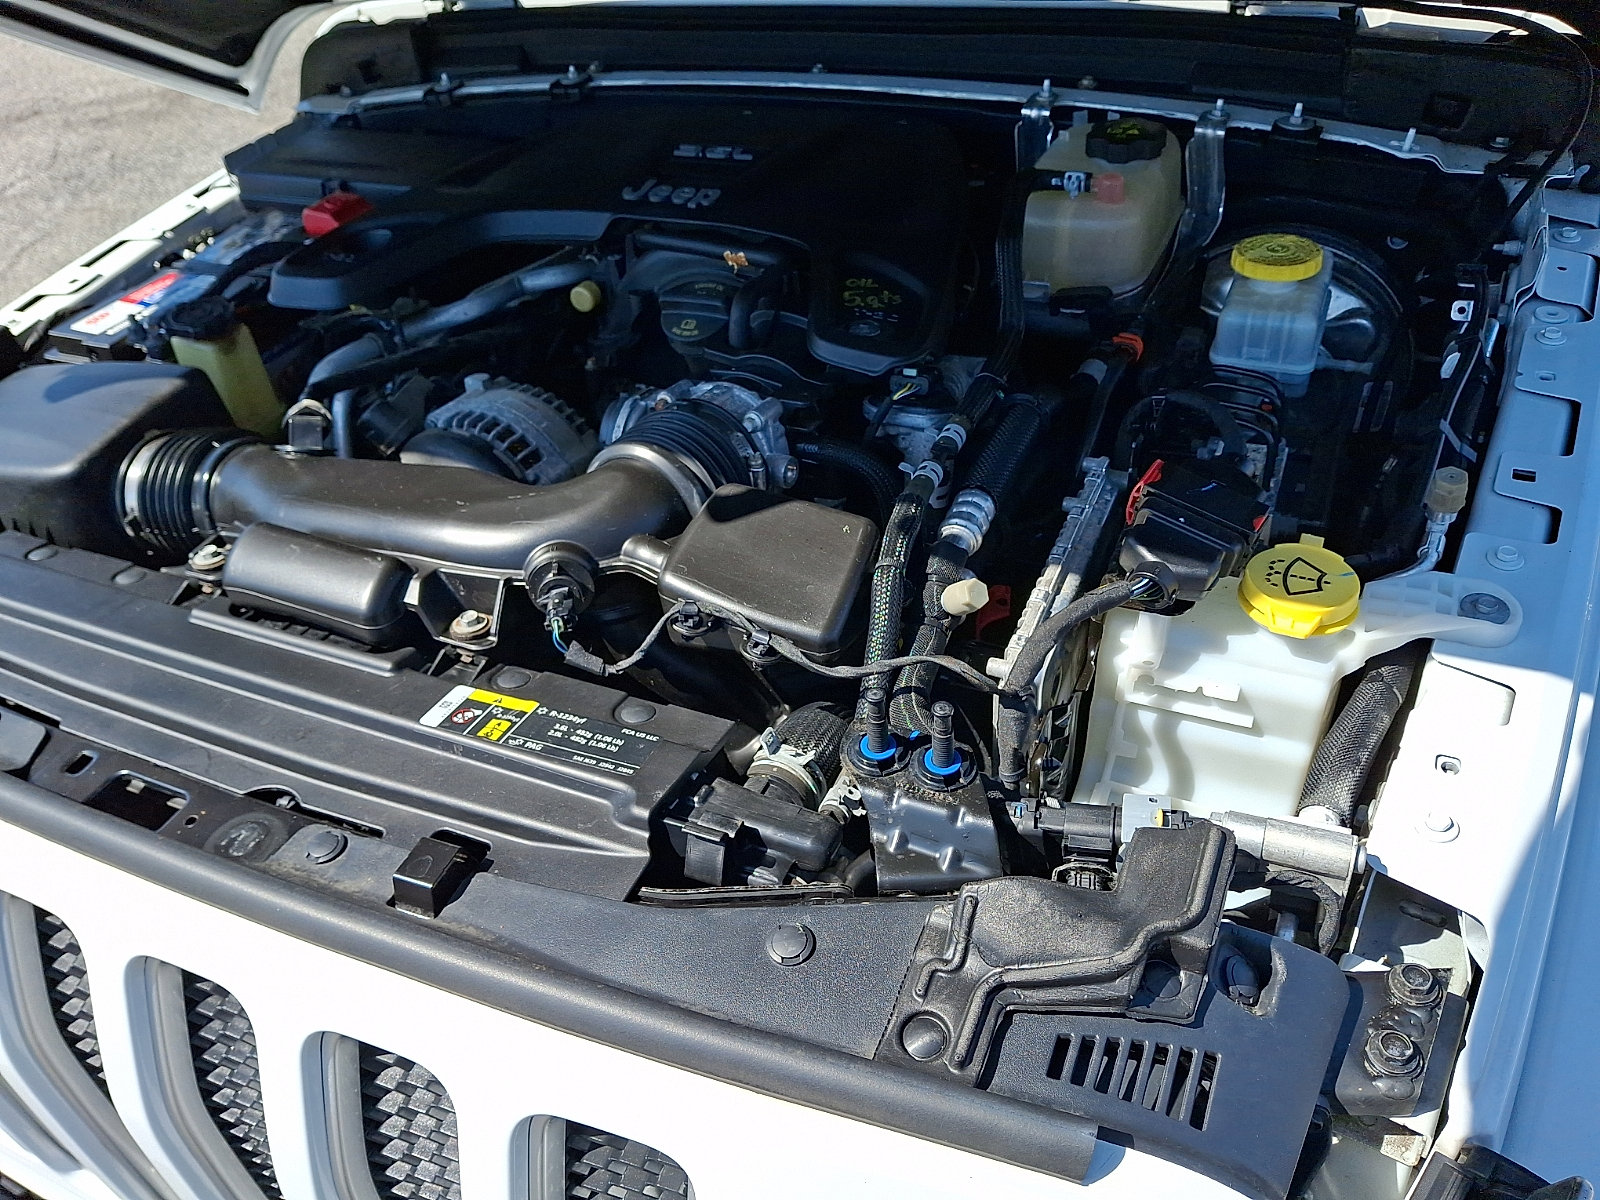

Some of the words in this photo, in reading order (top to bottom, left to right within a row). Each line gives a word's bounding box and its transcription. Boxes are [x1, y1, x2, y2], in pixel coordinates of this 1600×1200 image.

[621, 178, 722, 209] Jeep
[845, 278, 879, 288] OIL
[621, 728, 635, 736] FCA
[524, 741, 544, 751] PAG
